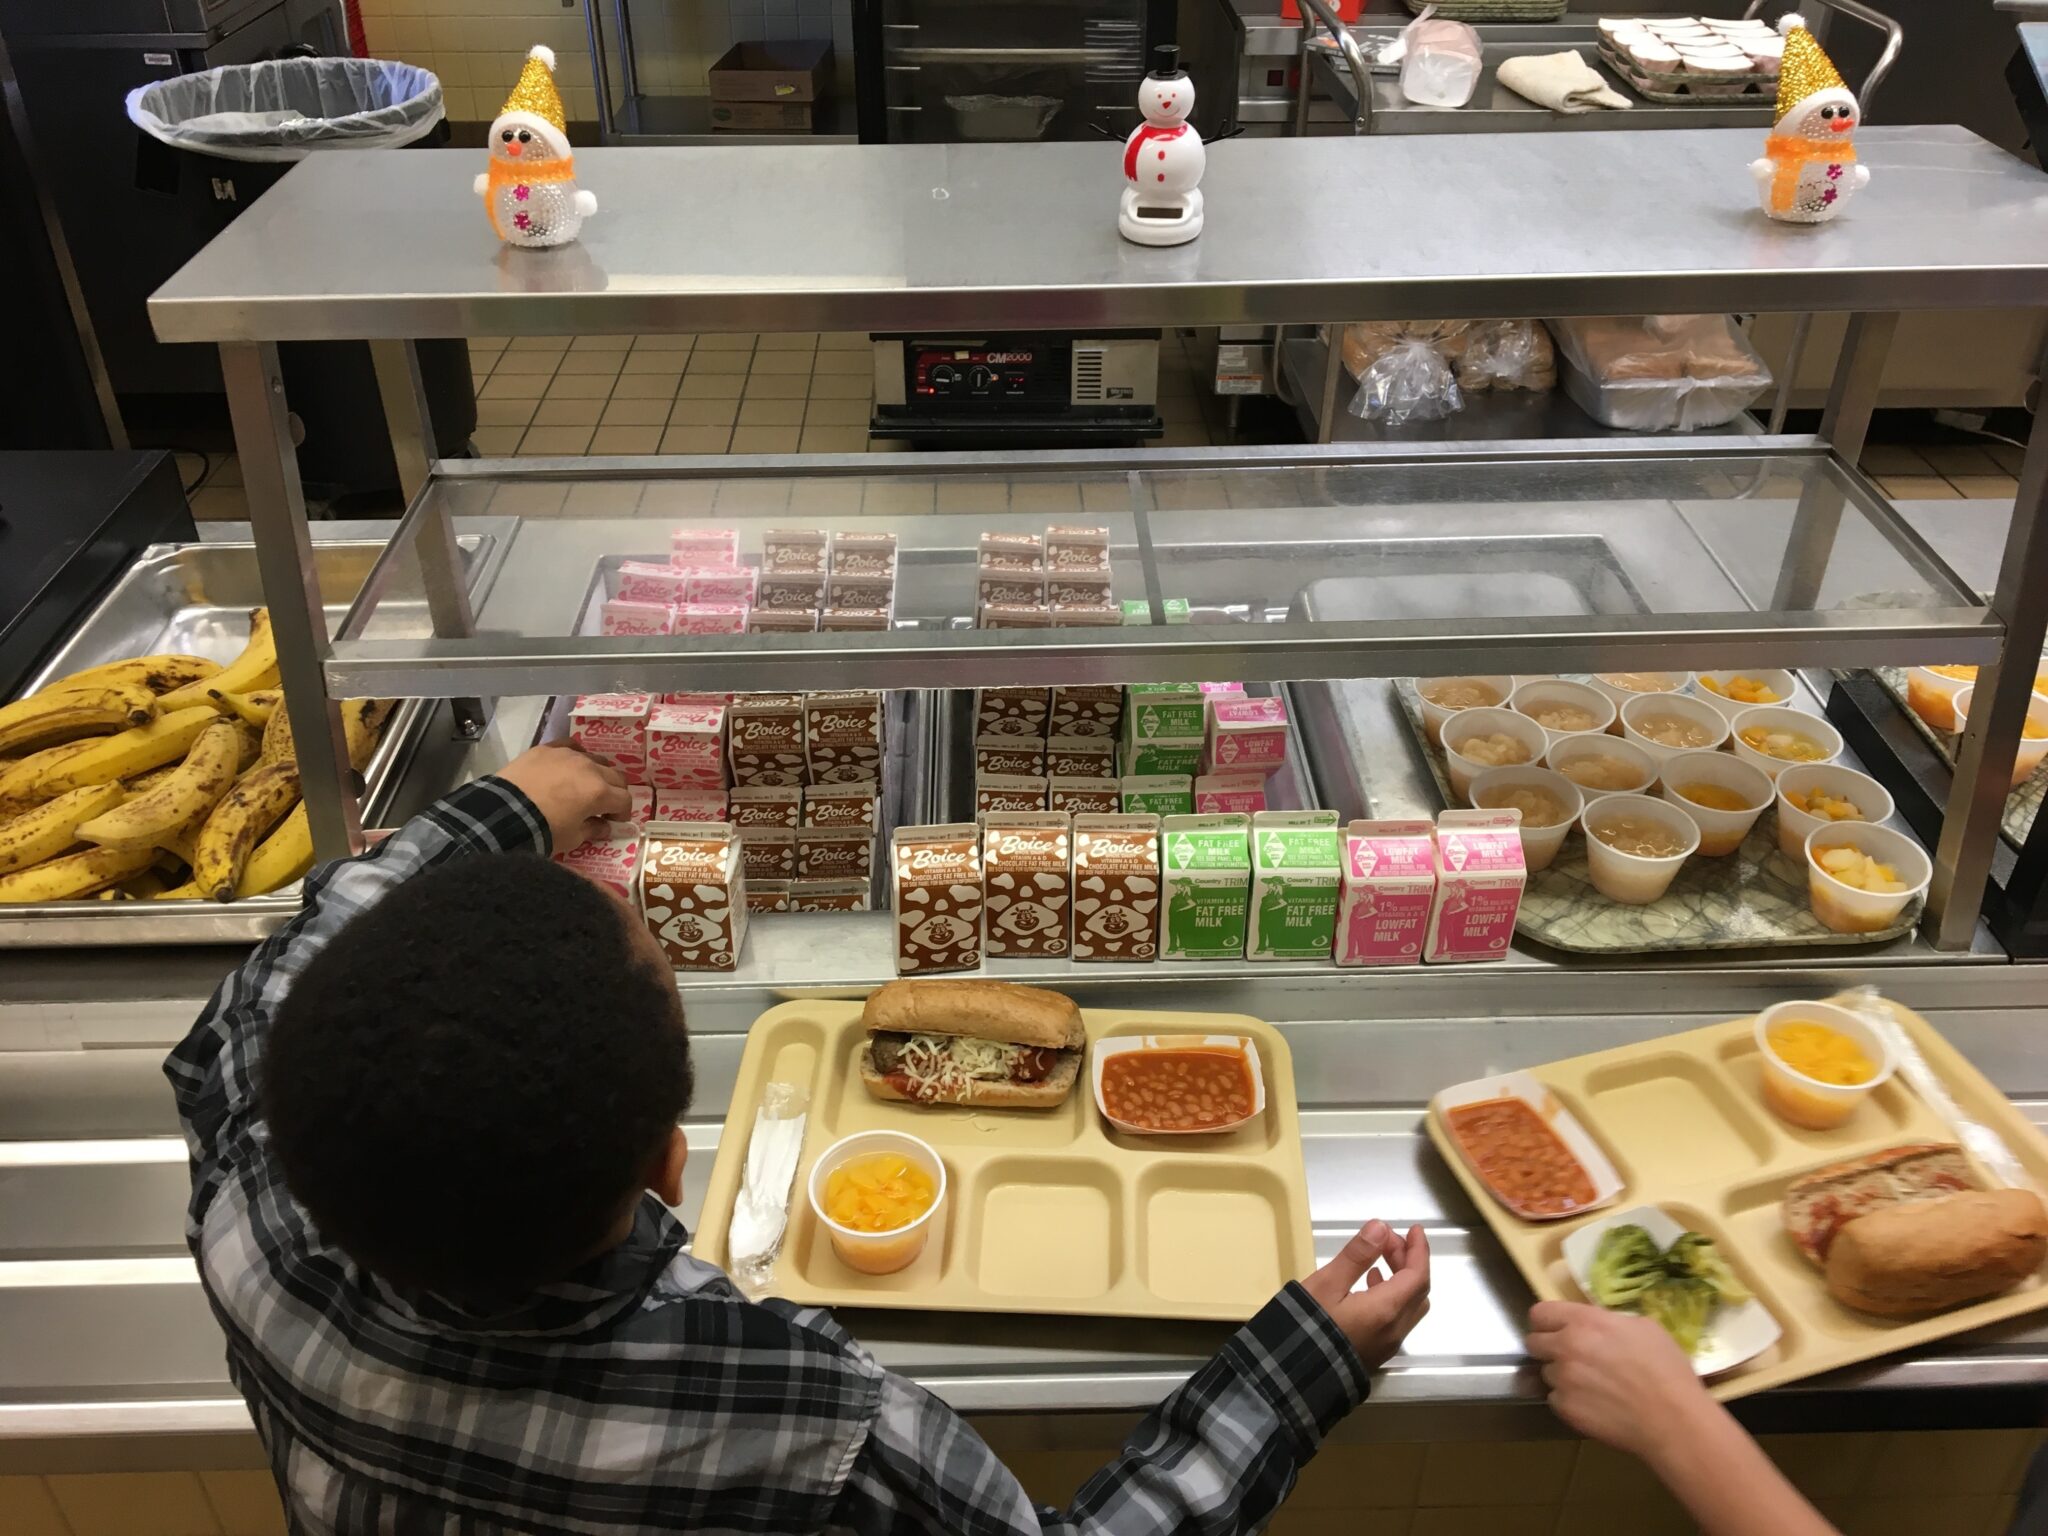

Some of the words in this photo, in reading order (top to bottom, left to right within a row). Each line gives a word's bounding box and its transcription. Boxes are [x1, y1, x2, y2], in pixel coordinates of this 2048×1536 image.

[987, 352, 1033, 364] CM2000
[775, 548, 816, 563] Boice
[845, 555, 884, 569] Boice
[1057, 549, 1097, 564] Boice
[770, 589, 813, 604] Boice
[842, 590, 883, 606] Boice
[990, 587, 1032, 602] Boice
[1059, 588, 1100, 602] Boice
[585, 719, 632, 737] Boice
[745, 721, 790, 739] Boice
[821, 714, 867, 732] Boice
[661, 735, 709, 752] Boice
[987, 756, 1031, 771] Boice
[1056, 759, 1099, 774] Boice
[989, 797, 1034, 811] Boice
[1063, 798, 1108, 812] Boice
[740, 808, 785, 823] Boice
[815, 804, 860, 821] Boice
[568, 840, 622, 858] Boice
[1000, 836, 1053, 855] Boice
[1091, 839, 1144, 857] Boice
[1289, 838, 1303, 846] FAT
[1307, 838, 1330, 846] FREE
[1473, 841, 1508, 850] LOWFAT
[660, 847, 716, 865] Boice
[809, 847, 856, 865] Boice
[1299, 846, 1321, 854] MILK
[1383, 847, 1418, 856] LOWFAT
[1481, 849, 1504, 858] MILK
[912, 849, 967, 869] Boice
[1391, 856, 1414, 864] MILK
[1224, 877, 1248, 886] TRIM
[751, 901, 772, 911] ice
[1380, 902, 1398, 911] 1%
[1471, 896, 1488, 906] 1%
[1196, 906, 1215, 916] FAT
[1218, 905, 1244, 915] FREE
[1286, 906, 1306, 915] FAT
[1308, 905, 1334, 915] FREE
[1195, 917, 1223, 927] MILK
[1285, 916, 1313, 927] MILK
[1376, 919, 1417, 929] LOWFAT
[1465, 913, 1507, 924] LOWFAT
[1373, 931, 1400, 942] MILK
[1463, 926, 1490, 936] MILK
